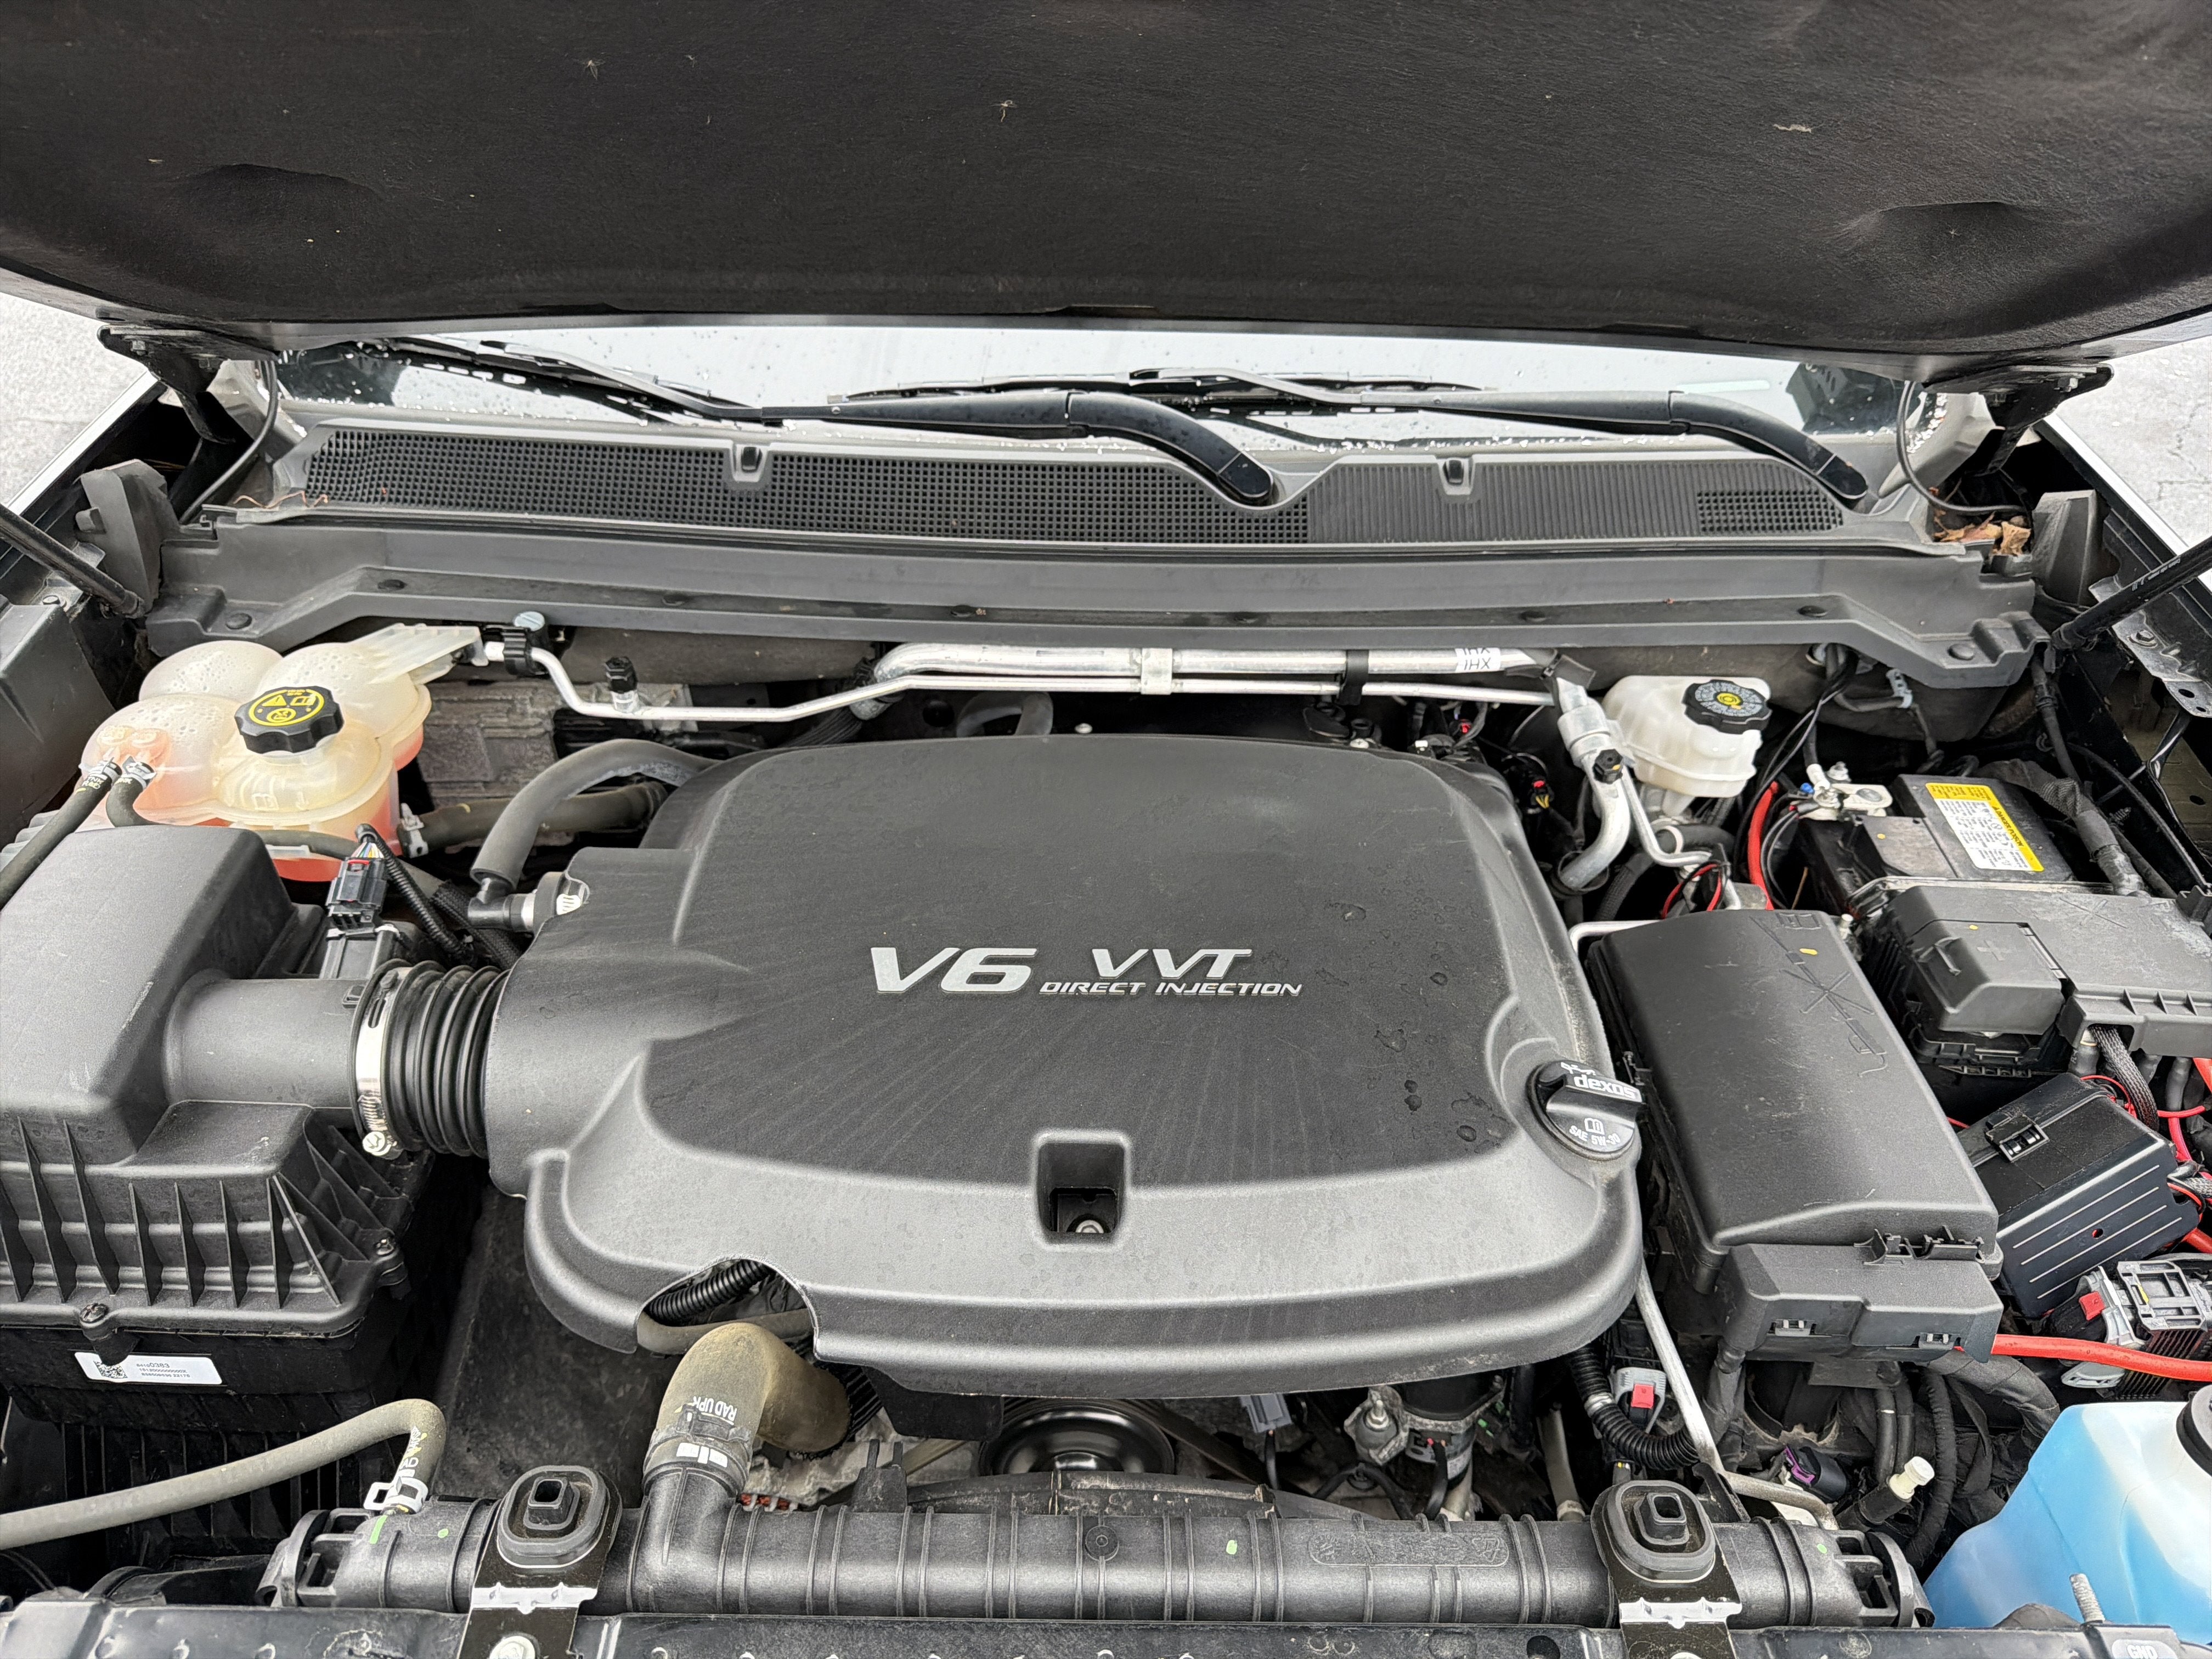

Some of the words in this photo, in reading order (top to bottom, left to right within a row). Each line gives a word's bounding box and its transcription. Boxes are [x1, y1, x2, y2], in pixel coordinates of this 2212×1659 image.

[1464, 657, 1491, 670] IHX
[871, 947, 1037, 994] V6
[1092, 949, 1253, 980] VVT
[1039, 981, 1147, 996] DIRECT
[1154, 982, 1302, 997] INJECTION
[1573, 1074, 1636, 1100] dexos
[1569, 1125, 1588, 1142] SAE
[1591, 1133, 1621, 1146] 5W-30
[715, 1401, 737, 1421] RAD
[2126, 1644, 2158, 1659] GND
